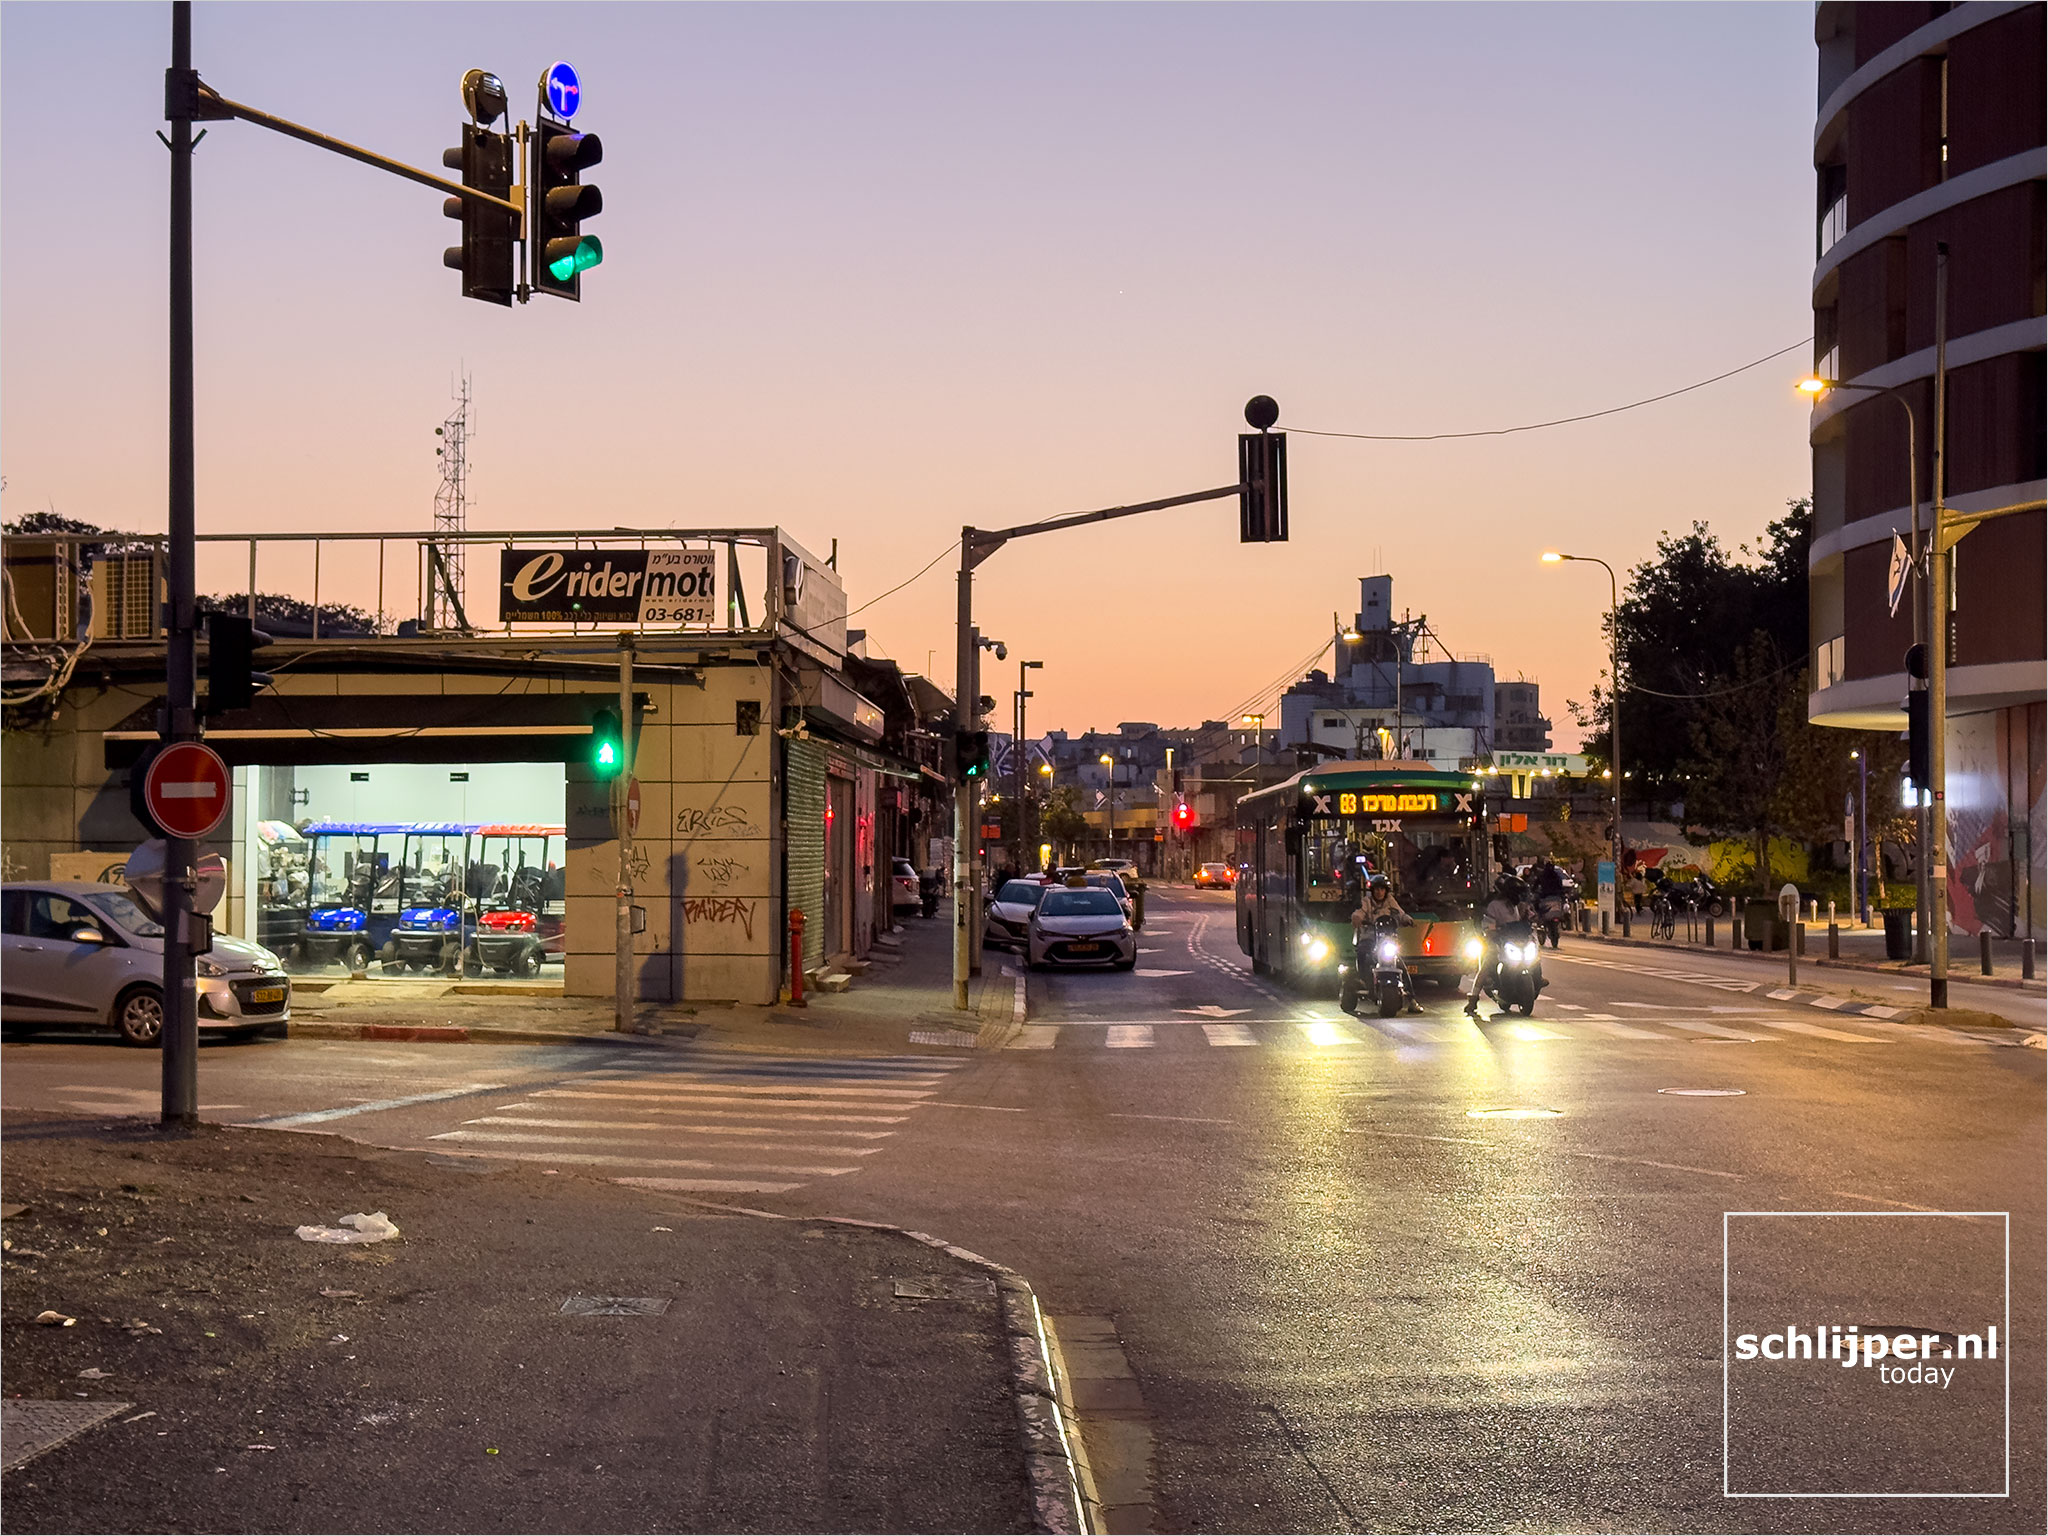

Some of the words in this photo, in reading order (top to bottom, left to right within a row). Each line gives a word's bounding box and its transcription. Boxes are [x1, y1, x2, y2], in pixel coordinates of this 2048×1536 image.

[541, 610, 563, 621] 100%
[1500, 753, 1538, 767] אלון
[1542, 756, 1567, 766] דור
[1361, 795, 1397, 812] מרכז
[1398, 794, 1437, 812] רכבת
[1371, 819, 1402, 833] אגד
